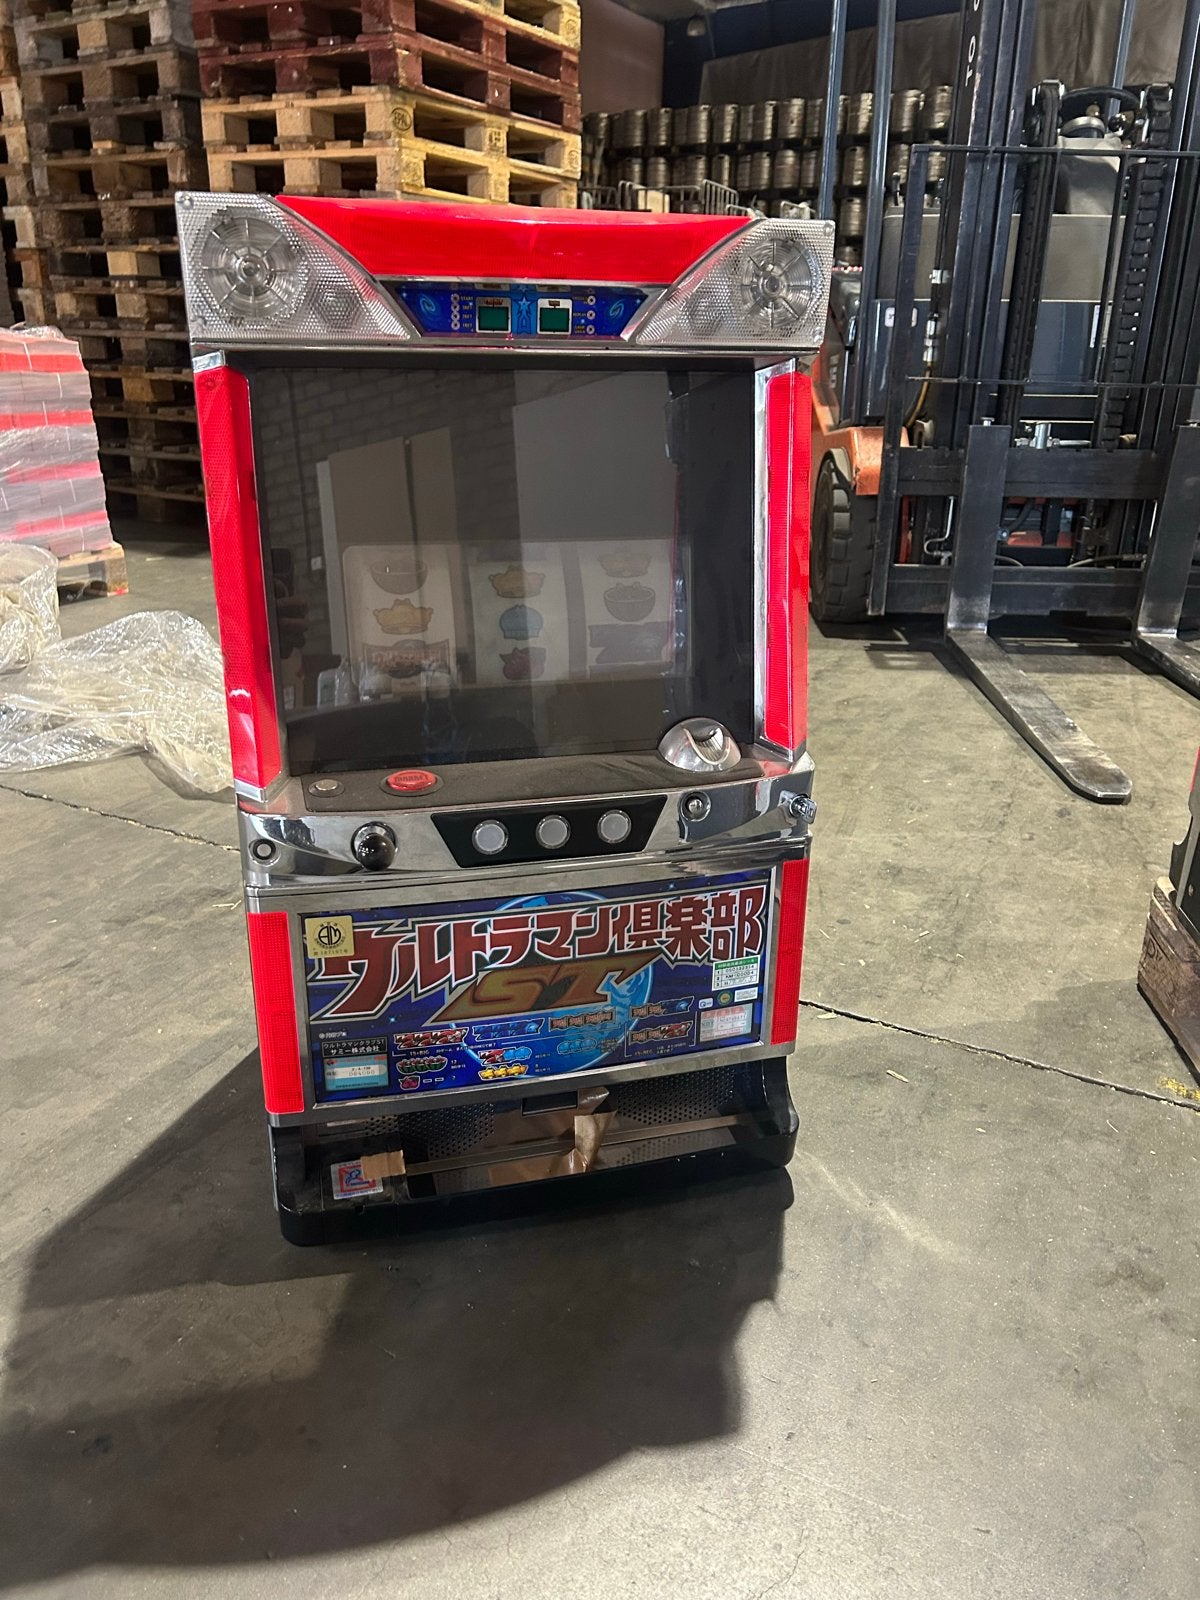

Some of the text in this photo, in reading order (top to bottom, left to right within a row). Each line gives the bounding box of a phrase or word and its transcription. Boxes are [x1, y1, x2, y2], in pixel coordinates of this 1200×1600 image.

[315, 885, 767, 1018] ウルトラマン倶楽部
